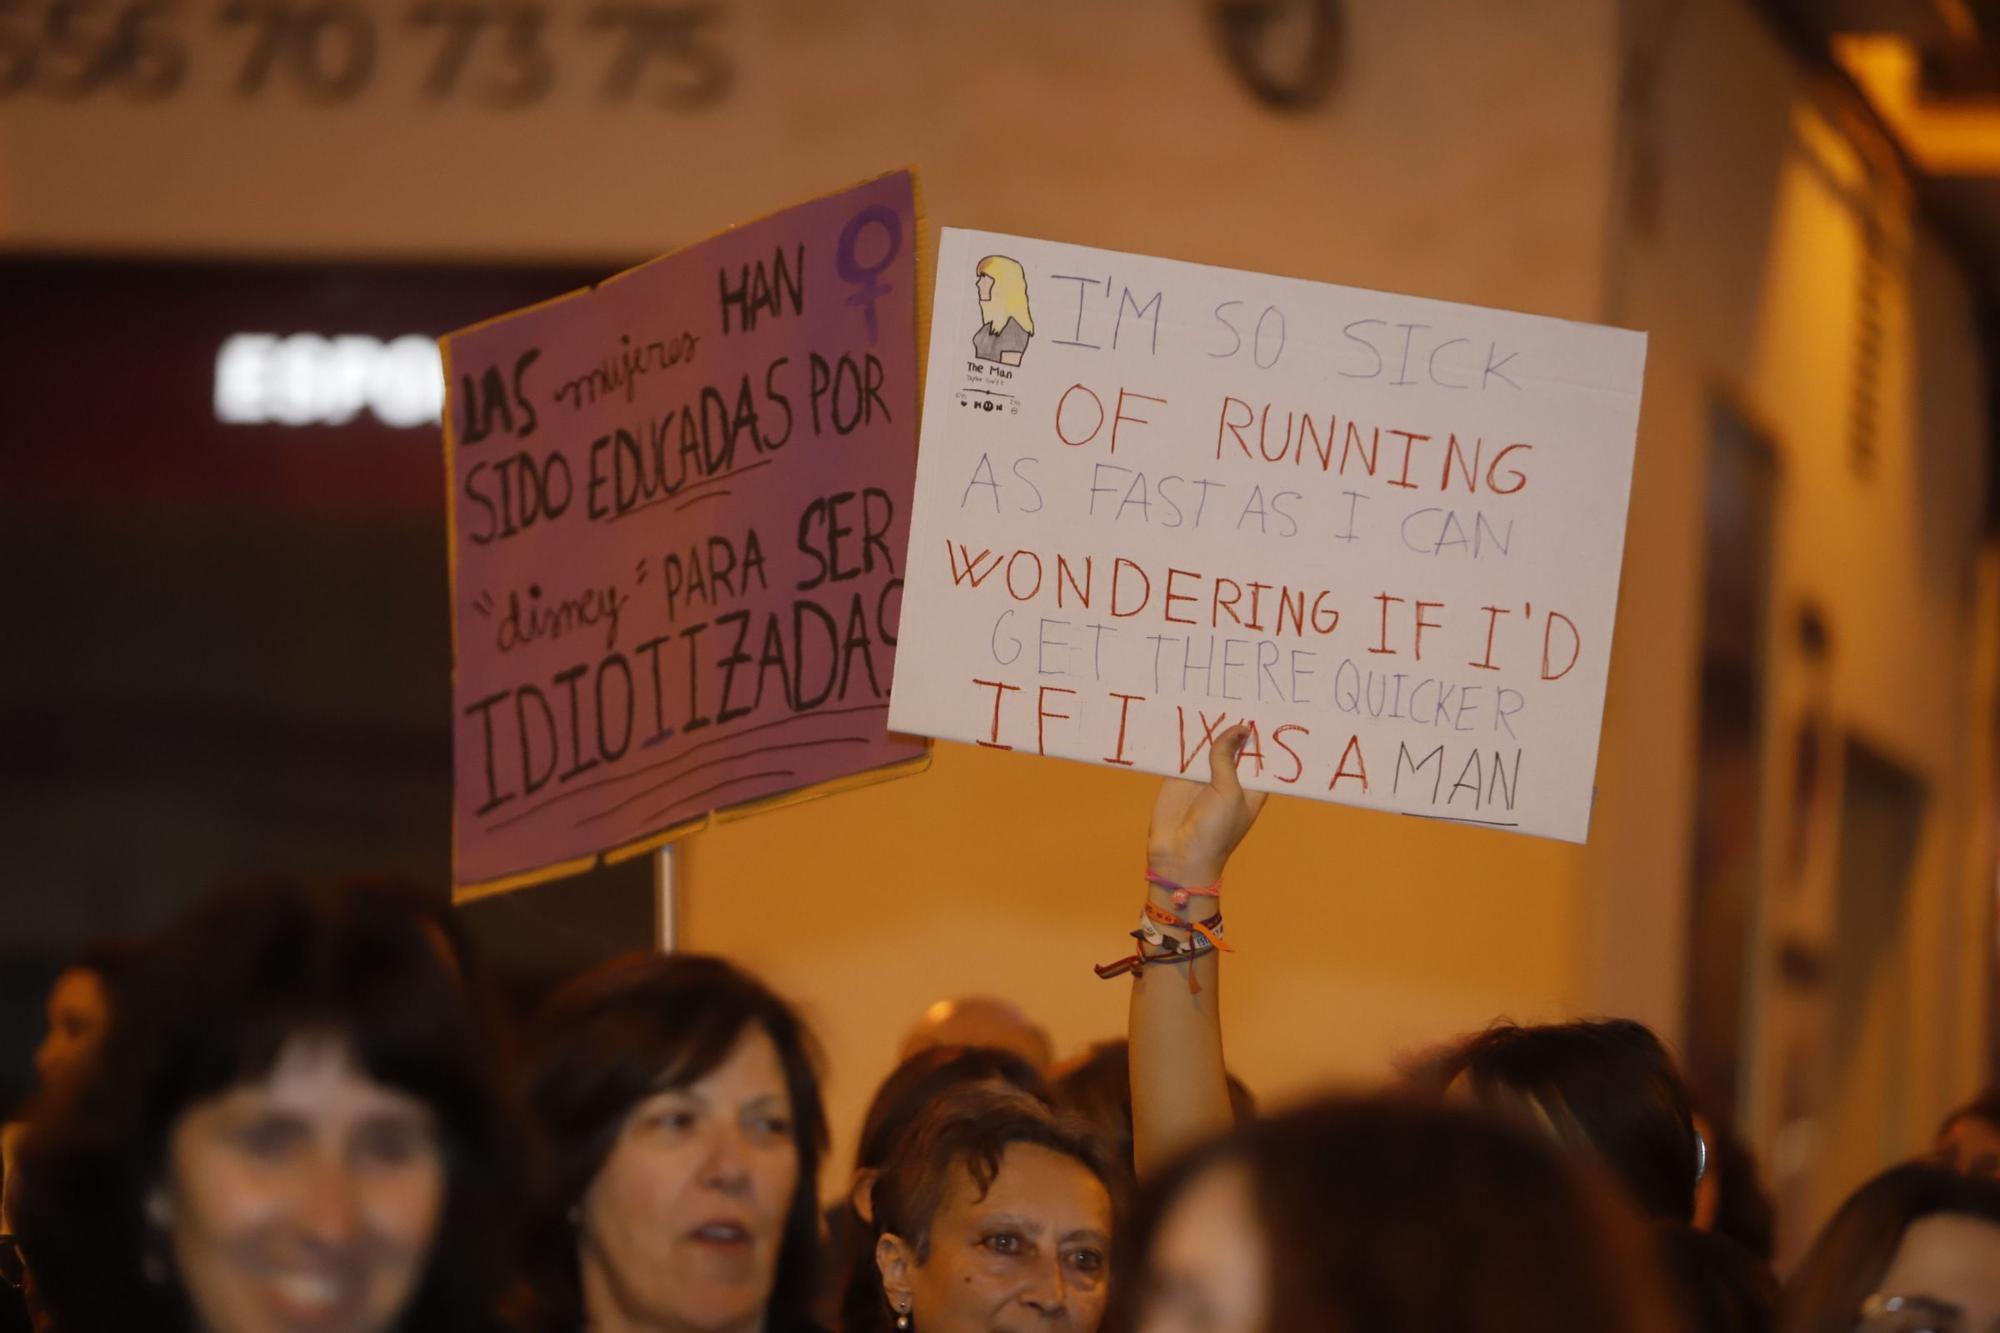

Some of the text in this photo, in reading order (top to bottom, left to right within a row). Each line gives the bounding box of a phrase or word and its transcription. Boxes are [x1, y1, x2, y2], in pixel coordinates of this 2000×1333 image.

[461, 245, 804, 444] LAS mujeres HAN
[967, 361, 1012, 379] The Man
[1049, 272, 1523, 392] I'M SO SICK
[464, 350, 892, 545] SIDO EDUCADAS POR
[960, 452, 1514, 558] AS FAST AS I CAN
[1055, 383, 1533, 496] OF RUNNING
[663, 528, 767, 622] PARA
[796, 487, 893, 592] SER
[945, 538, 1581, 682] WONDERING IF I'D
[991, 608, 1526, 740] GET THERE QUICKER
[971, 678, 1077, 757] IF
[1102, 691, 1146, 765] I
[1328, 733, 1370, 793] A
[1391, 739, 1522, 812] MAN
